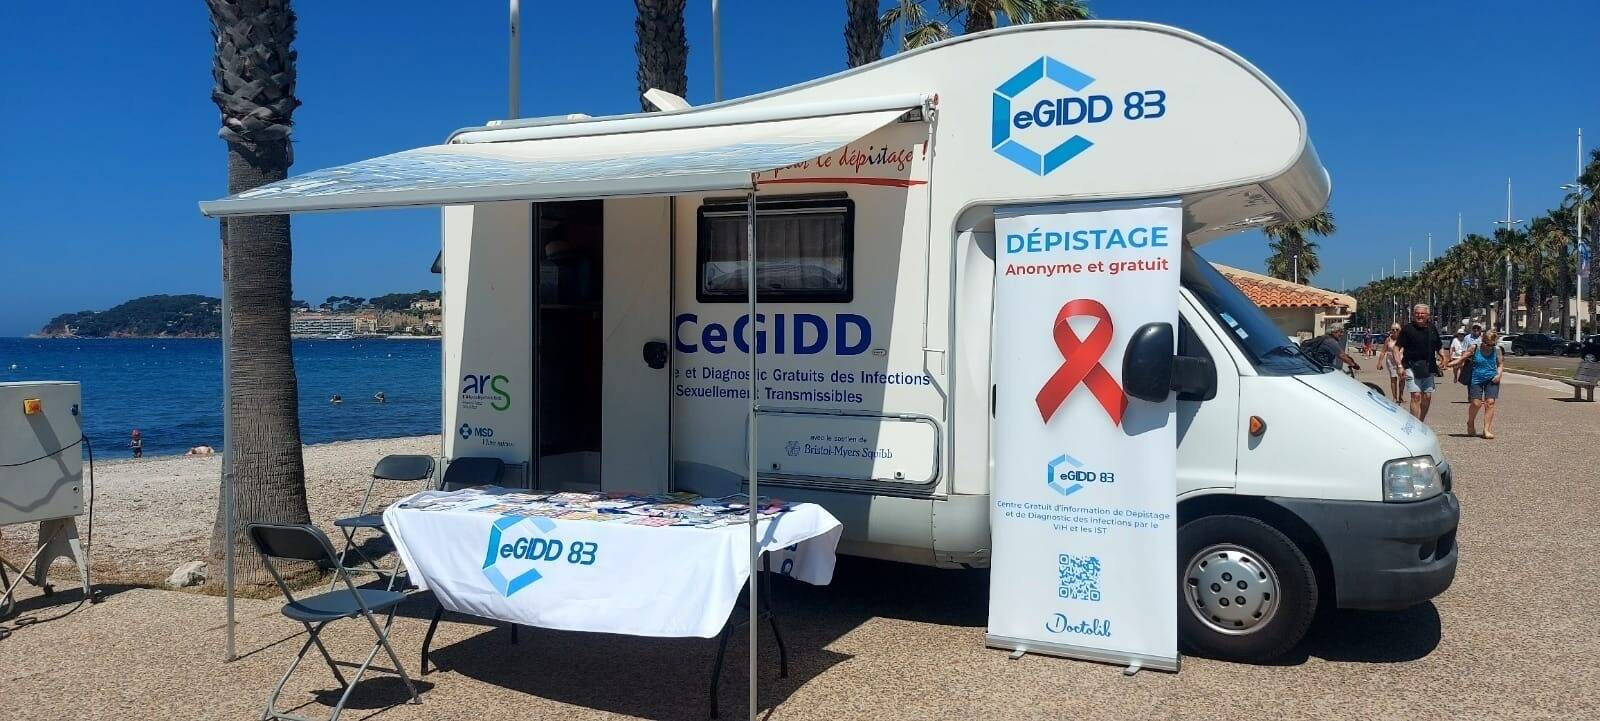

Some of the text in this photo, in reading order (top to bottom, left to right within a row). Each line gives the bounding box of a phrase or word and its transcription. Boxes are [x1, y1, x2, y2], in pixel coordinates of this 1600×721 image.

[1124, 90, 1166, 120] 83
[839, 144, 914, 173] dépistage
[1006, 227, 1169, 254] DÉPISTAGE
[1005, 257, 1169, 277] Anonyme et gratuit
[675, 313, 872, 356] CeGIDD
[685, 369, 697, 379] et
[702, 367, 767, 383] Diagnosic
[772, 368, 824, 383] Gratuits
[830, 369, 855, 384] des
[861, 370, 930, 385] Infections
[463, 374, 511, 411] ars
[765, 387, 863, 403] Transmissibles
[474, 427, 494, 437] MSD
[1099, 472, 1115, 483] 83
[997, 500, 1022, 509] Centre
[1024, 502, 1052, 511] Gratuit
[1112, 508, 1124, 516] de
[1016, 511, 1026, 519] de
[1028, 512, 1071, 523] Diagnostic
[1073, 515, 1089, 524] des
[1134, 521, 1149, 530] par
[1069, 524, 1079, 532] et
[567, 541, 598, 565] 83
[1045, 612, 1111, 637] Doctolib
